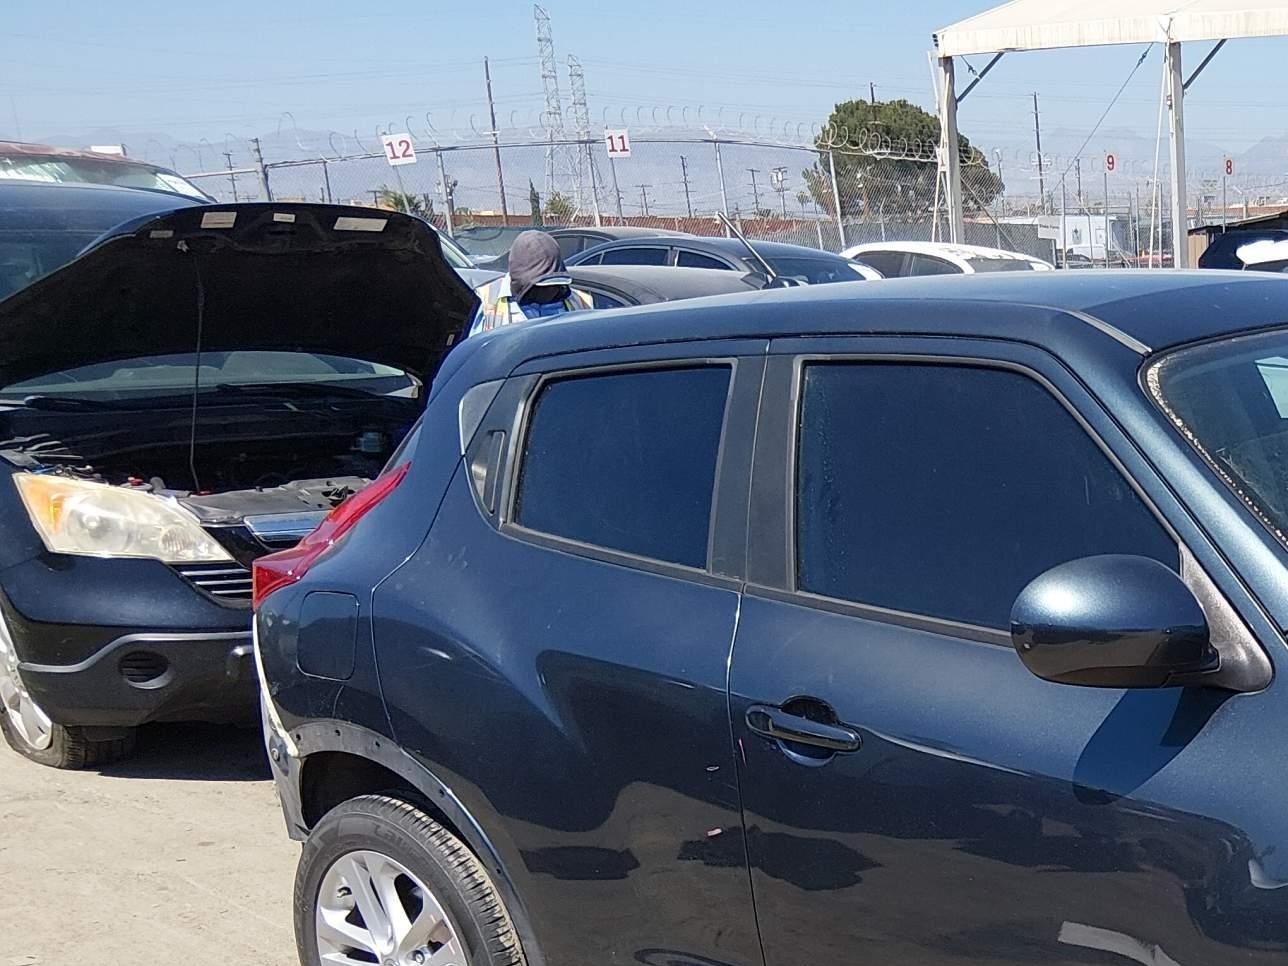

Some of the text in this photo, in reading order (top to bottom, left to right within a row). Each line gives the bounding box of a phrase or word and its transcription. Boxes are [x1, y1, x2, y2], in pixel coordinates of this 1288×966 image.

[385, 140, 413, 160] 12
[607, 135, 629, 152] 11
[1107, 155, 1114, 171] 9
[1226, 160, 1232, 175] 8
